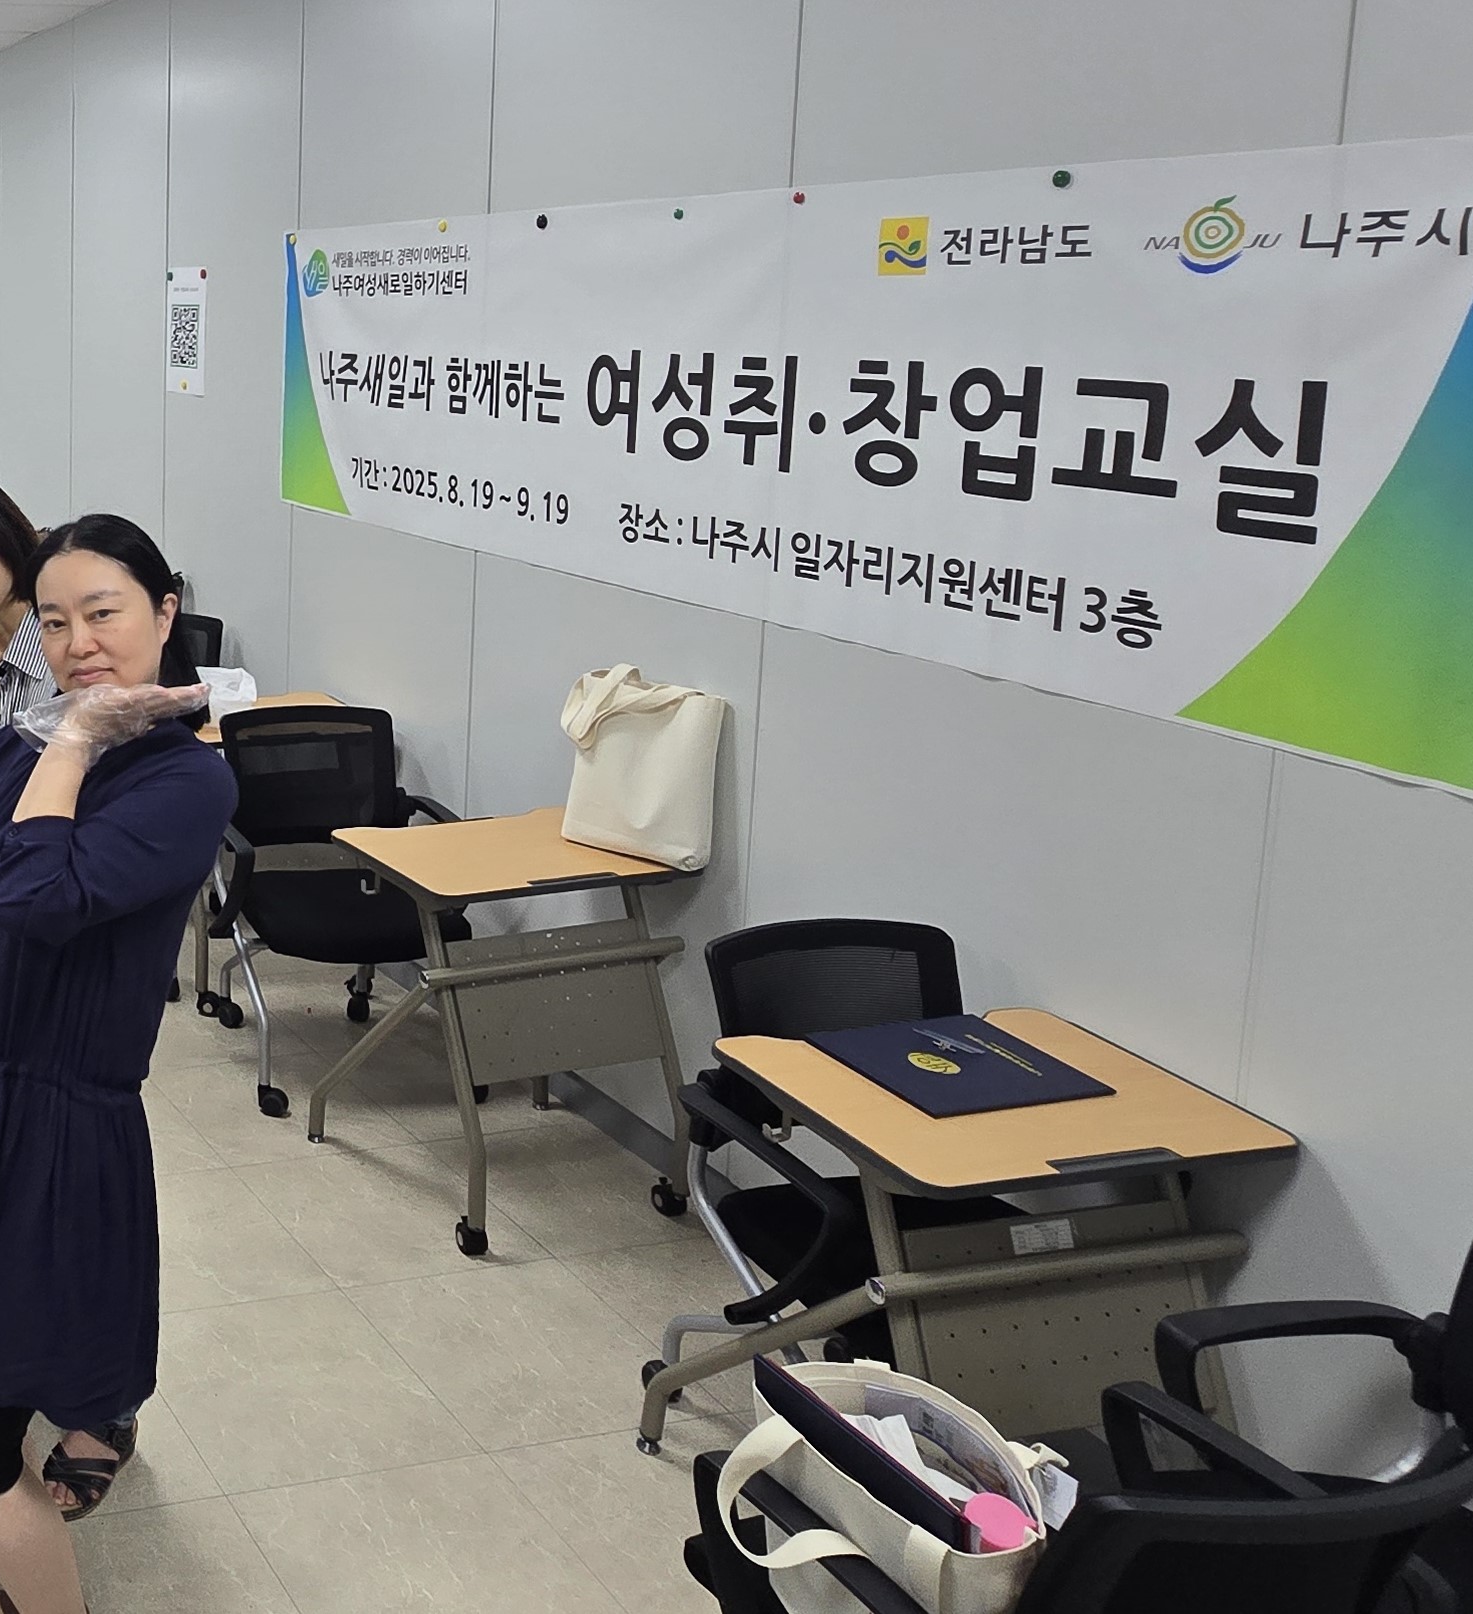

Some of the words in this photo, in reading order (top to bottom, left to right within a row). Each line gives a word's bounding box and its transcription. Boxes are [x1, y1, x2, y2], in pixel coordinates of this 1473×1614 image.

[940, 224, 1093, 265] 전라남도
[1300, 206, 1473, 258] 나주시
[332, 251, 354, 268] 새일을
[355, 249, 395, 267] 시작합니다.
[397, 247, 422, 266] 경력이
[424, 244, 471, 263] 이어집니다.
[332, 270, 468, 297] 나주여성새로일하기센터
[319, 350, 436, 412] 나주새일과
[446, 357, 565, 424] 함께하는
[691, 516, 781, 573] 나주시
[790, 532, 1066, 632] 일자리지원센터
[1078, 586, 1163, 650] 3층
